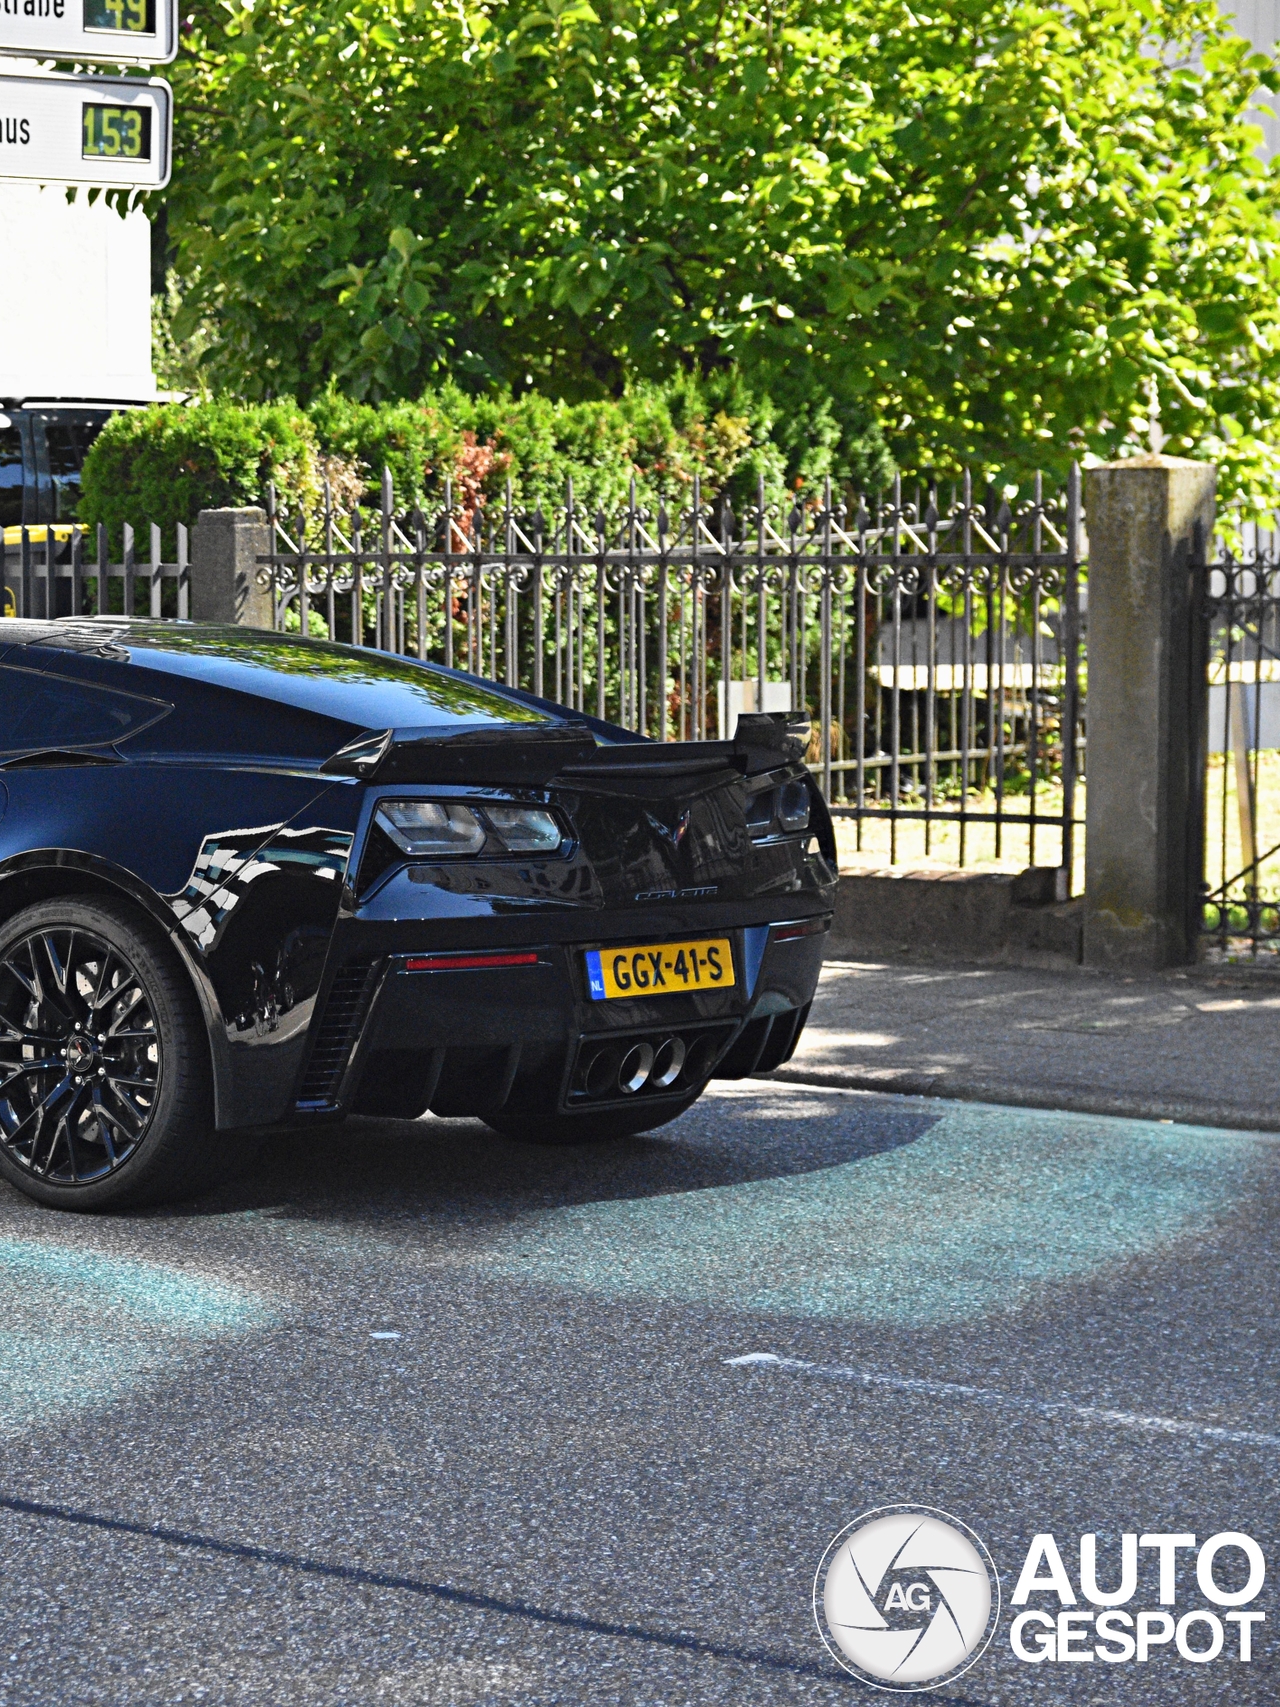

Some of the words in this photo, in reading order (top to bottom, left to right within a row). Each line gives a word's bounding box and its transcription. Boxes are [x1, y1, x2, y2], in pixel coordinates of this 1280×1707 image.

[83, 106, 142, 156] 153
[591, 980, 603, 991] NL
[612, 946, 724, 991] GGX-41-S
